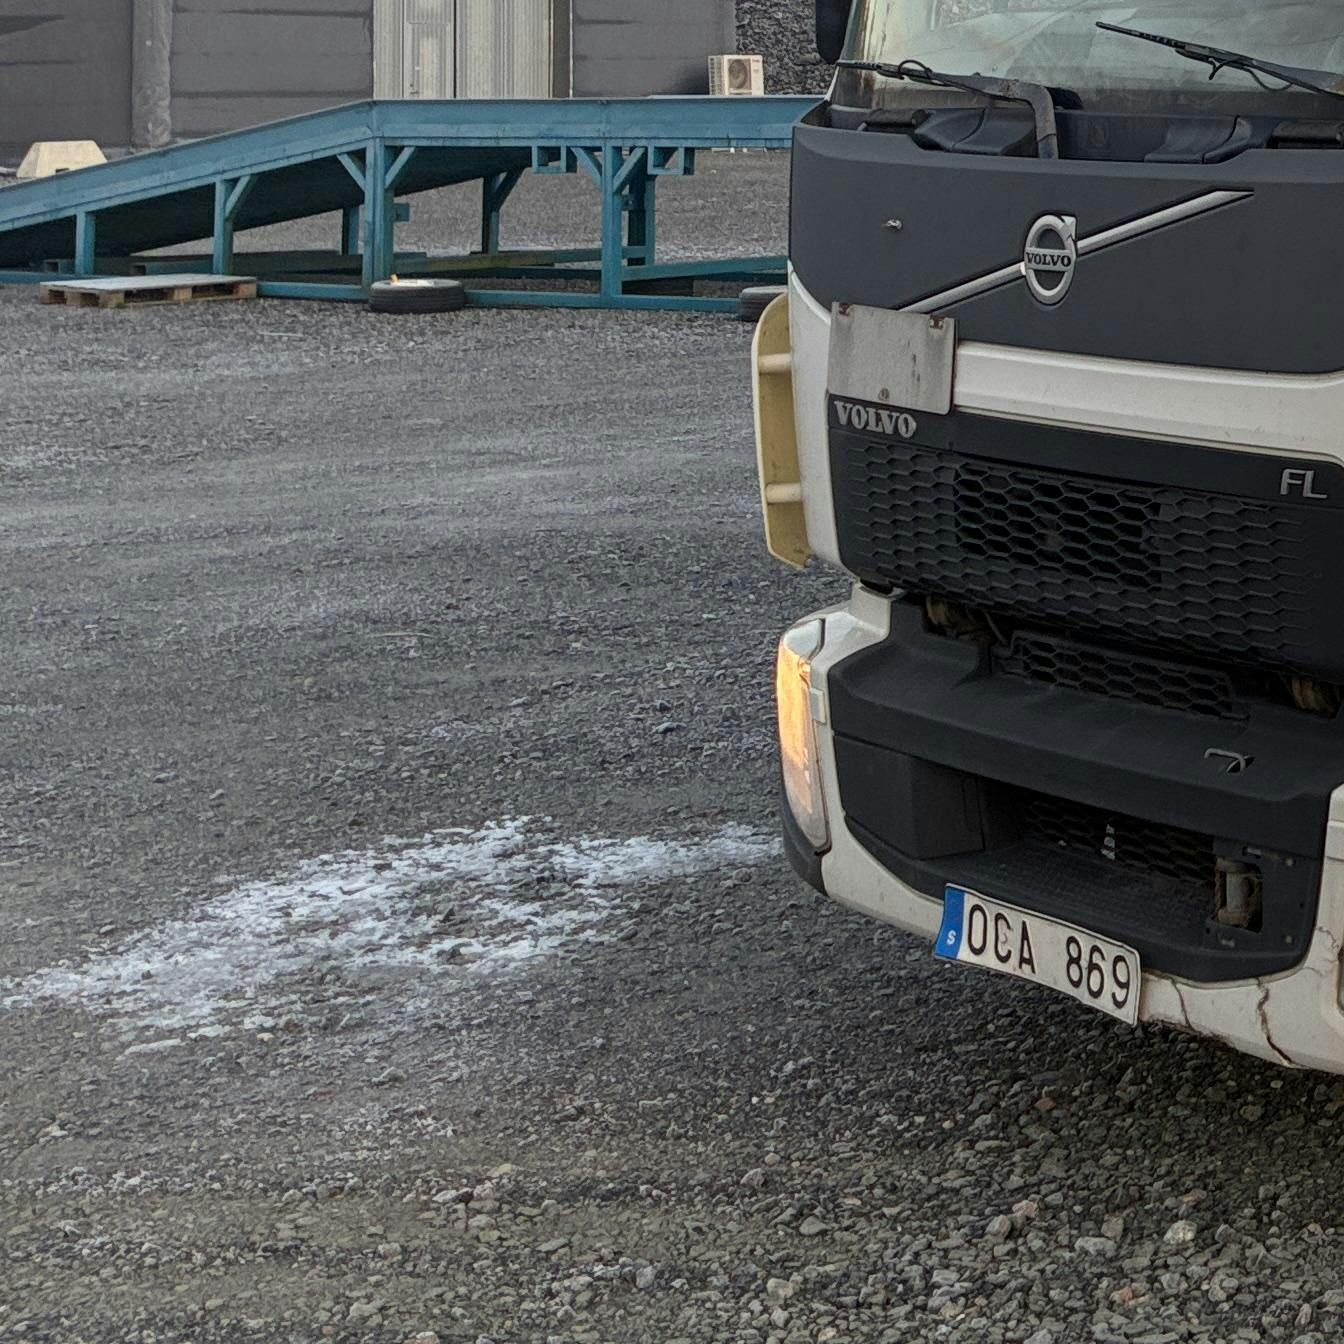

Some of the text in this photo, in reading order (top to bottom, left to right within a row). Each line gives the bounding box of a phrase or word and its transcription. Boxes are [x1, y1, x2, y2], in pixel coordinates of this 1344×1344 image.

[1025, 251, 1072, 268] VOLVO
[833, 399, 918, 439] VOLVO
[1279, 467, 1327, 500] FL
[946, 903, 1130, 1010] S OCA 869
